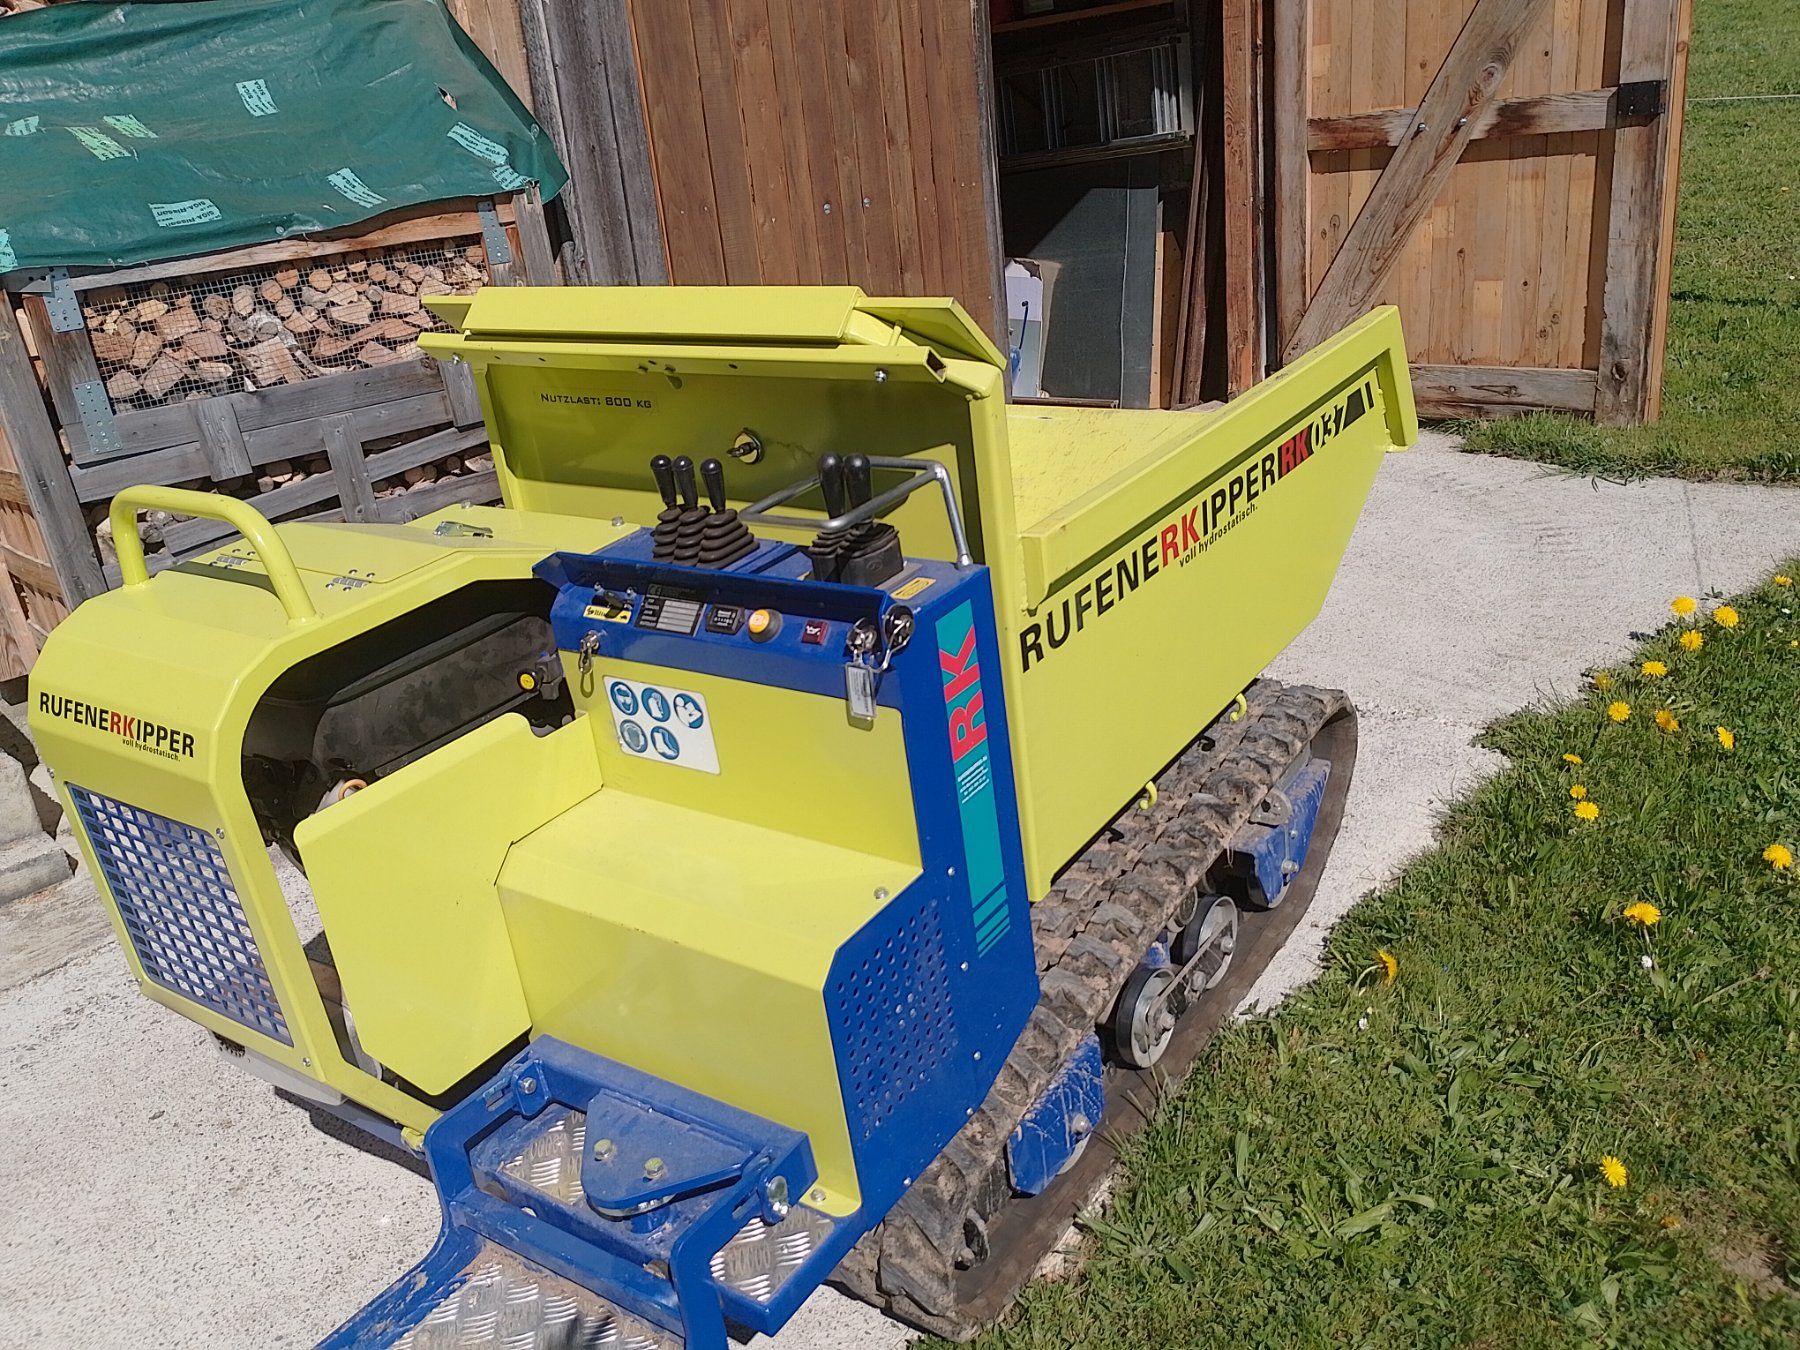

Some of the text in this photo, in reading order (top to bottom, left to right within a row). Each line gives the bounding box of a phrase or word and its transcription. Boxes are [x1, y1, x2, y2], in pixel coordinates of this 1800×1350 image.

[540, 393, 652, 409] NUTZLAST: 800 KG
[1019, 452, 1276, 674] RUFENERKIPPER
[1179, 502, 1258, 568] voll hydrostatisch.
[39, 691, 195, 758] RUFENERKIPPER
[938, 624, 988, 764] RK
[122, 738, 181, 762] voll hydrostatisch.
